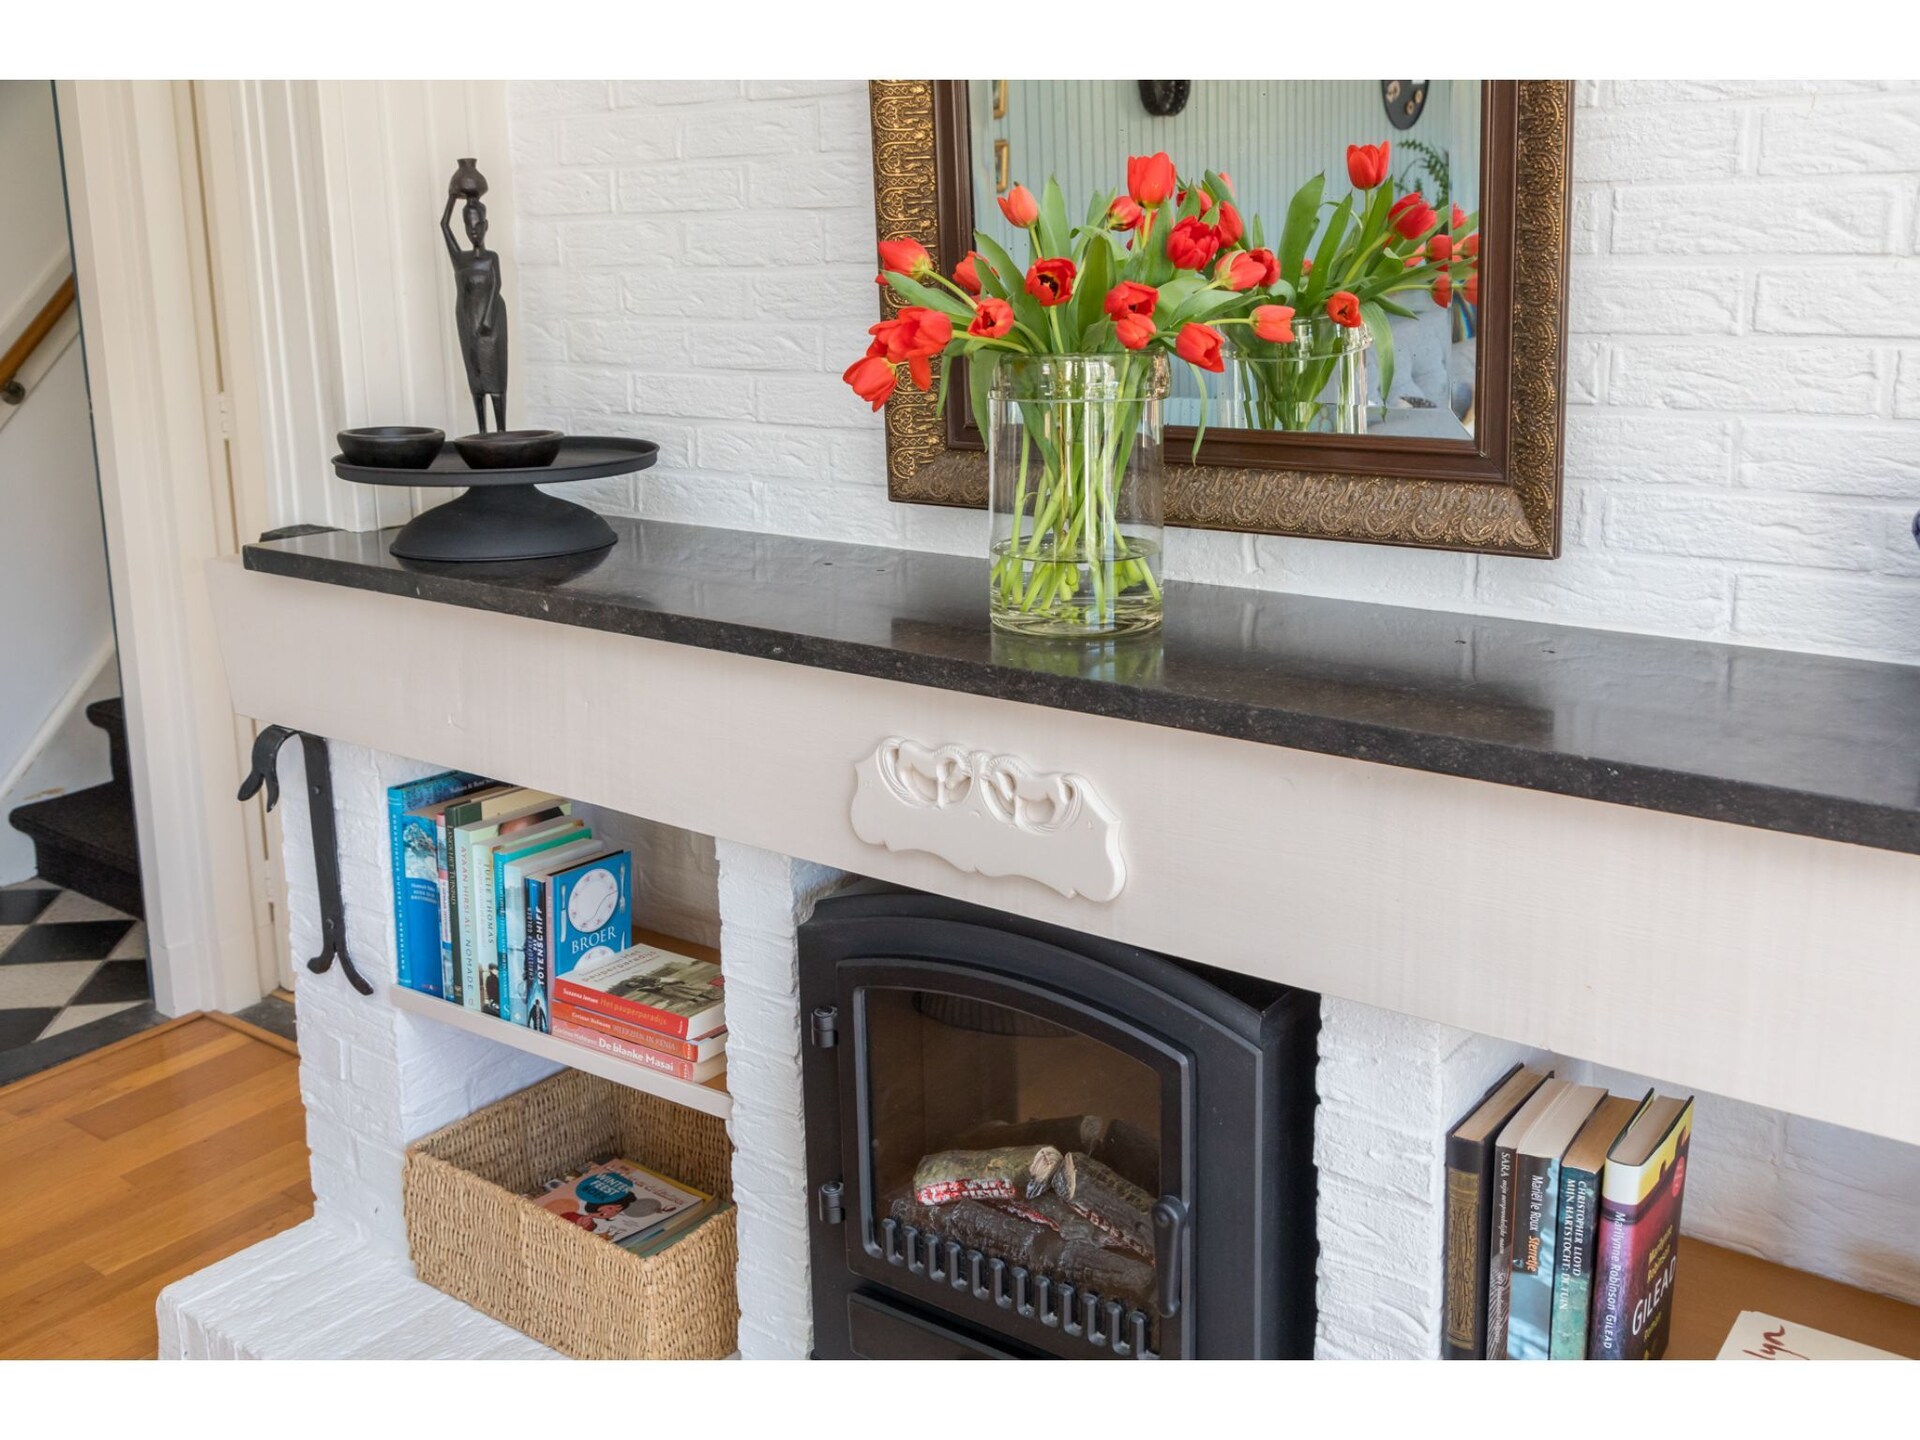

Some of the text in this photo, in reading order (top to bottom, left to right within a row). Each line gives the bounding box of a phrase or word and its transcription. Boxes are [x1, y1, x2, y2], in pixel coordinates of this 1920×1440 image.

[461, 847, 469, 881] AYAAN
[466, 940, 474, 990] NOMADE
[487, 900, 495, 944] THOMAS
[527, 935, 536, 980] CHRISTOPHER
[535, 906, 545, 986] TOTENSCHIFF
[571, 926, 616, 954] BROER
[599, 1037, 612, 1050] De
[613, 1043, 643, 1061] blanke
[645, 1053, 674, 1071] Masai
[1501, 1152, 1510, 1177] SARA
[590, 1180, 621, 1196] FEEST
[596, 1173, 632, 1194] WINTER
[1532, 1175, 1544, 1201] Mariël
[1565, 1179, 1576, 1203] MIJN
[1529, 1210, 1541, 1231] Roux
[1572, 1180, 1587, 1277] CHRISTOPHER LLOYD
[1526, 1235, 1540, 1272] Sterretje
[1562, 1206, 1574, 1271] HARTSTOCHT:
[1604, 1211, 1626, 1349] Marilynne Robinson GILEAD
[1632, 1255, 1677, 1336] GILEAD
[1559, 1288, 1569, 1310] TUIN
